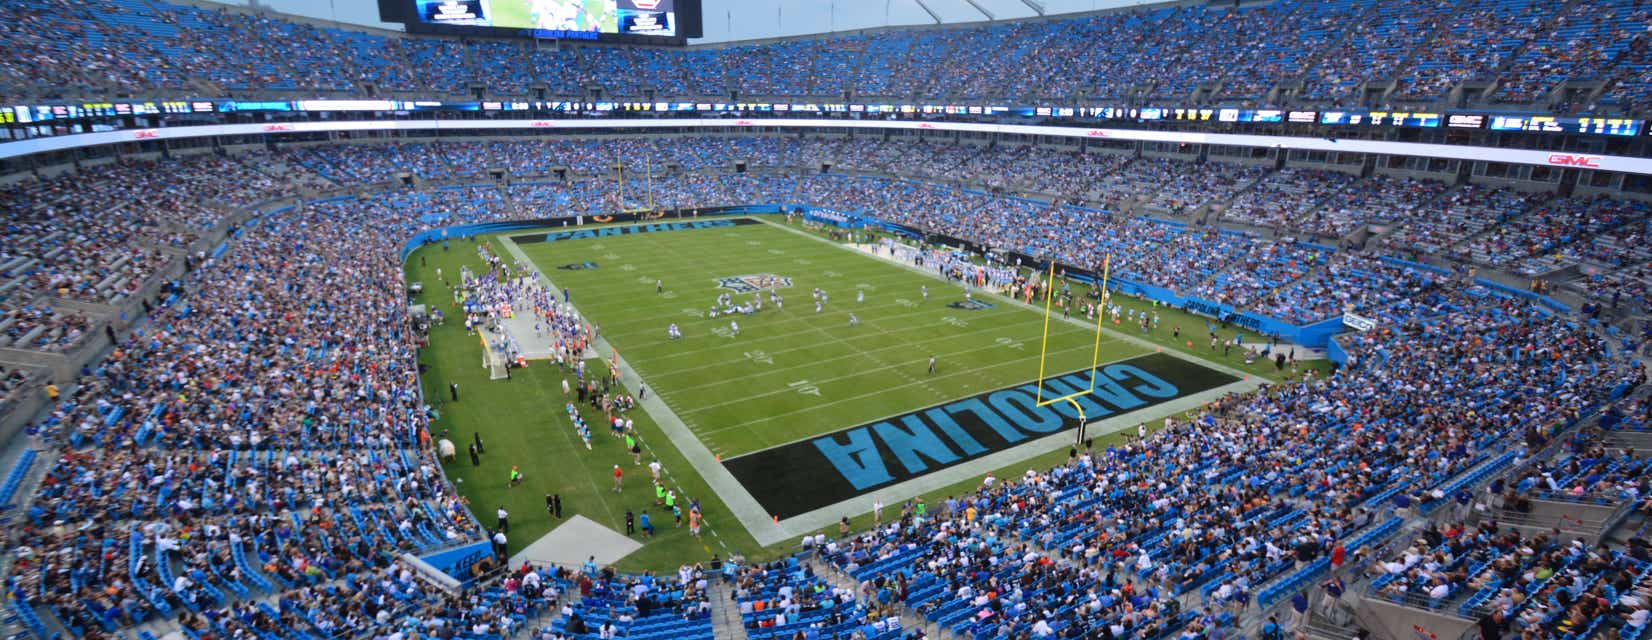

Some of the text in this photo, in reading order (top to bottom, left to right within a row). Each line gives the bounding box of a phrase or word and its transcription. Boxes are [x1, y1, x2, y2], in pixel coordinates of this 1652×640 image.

[1549, 154, 1601, 167] GMC
[545, 219, 736, 242] PANTHERS
[1345, 315, 1373, 329] GEICO
[813, 364, 1179, 491] CAROLINA
